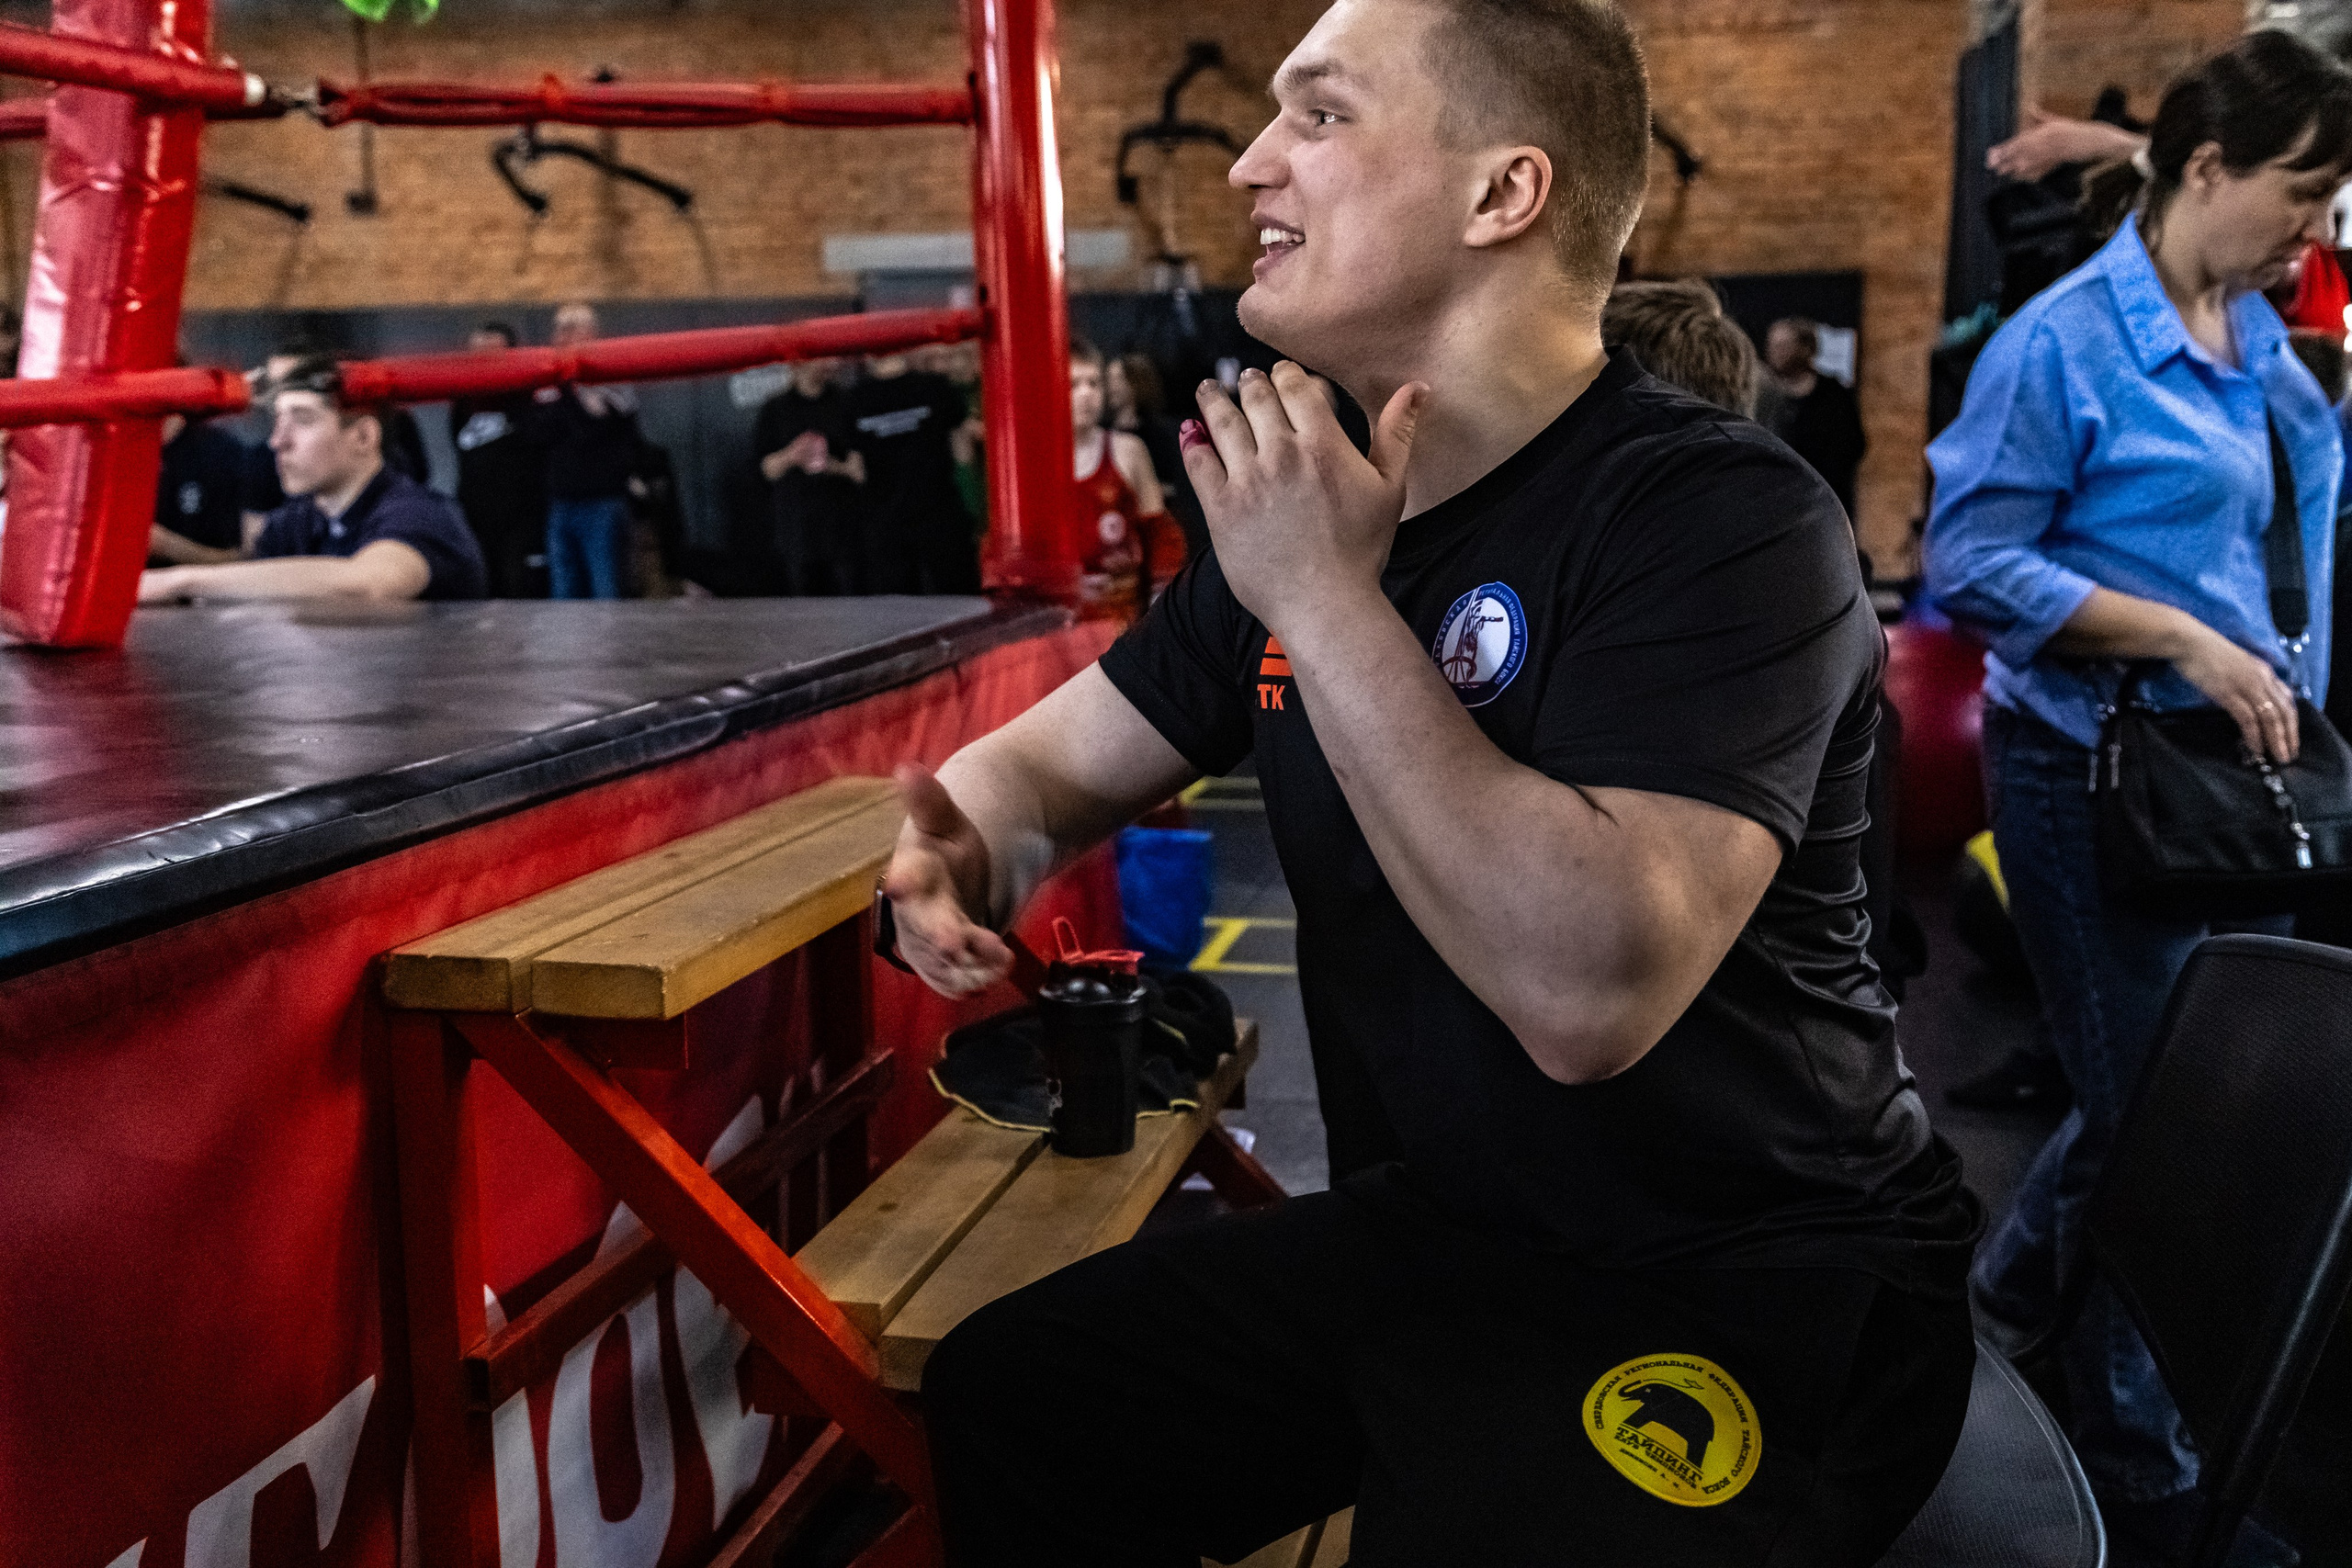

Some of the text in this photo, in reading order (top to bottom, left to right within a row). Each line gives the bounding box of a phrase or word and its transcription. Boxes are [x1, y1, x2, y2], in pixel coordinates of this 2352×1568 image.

[1507, 637, 1521, 669] ТАЙСКОГО
[1593, 1359, 1750, 1495] СВЕРДЛОВСКАЯ РЕГИОНАЛЬНАЯ ФЕДЕРАЦИЯ ТАЙСКОГО БОКСА
[1615, 1426, 1703, 1482] ТАЙПИНГ
[1614, 1435, 1639, 1450] КЛУБ
[1645, 1450, 1697, 1489] ЧЕМПИОНОВ
